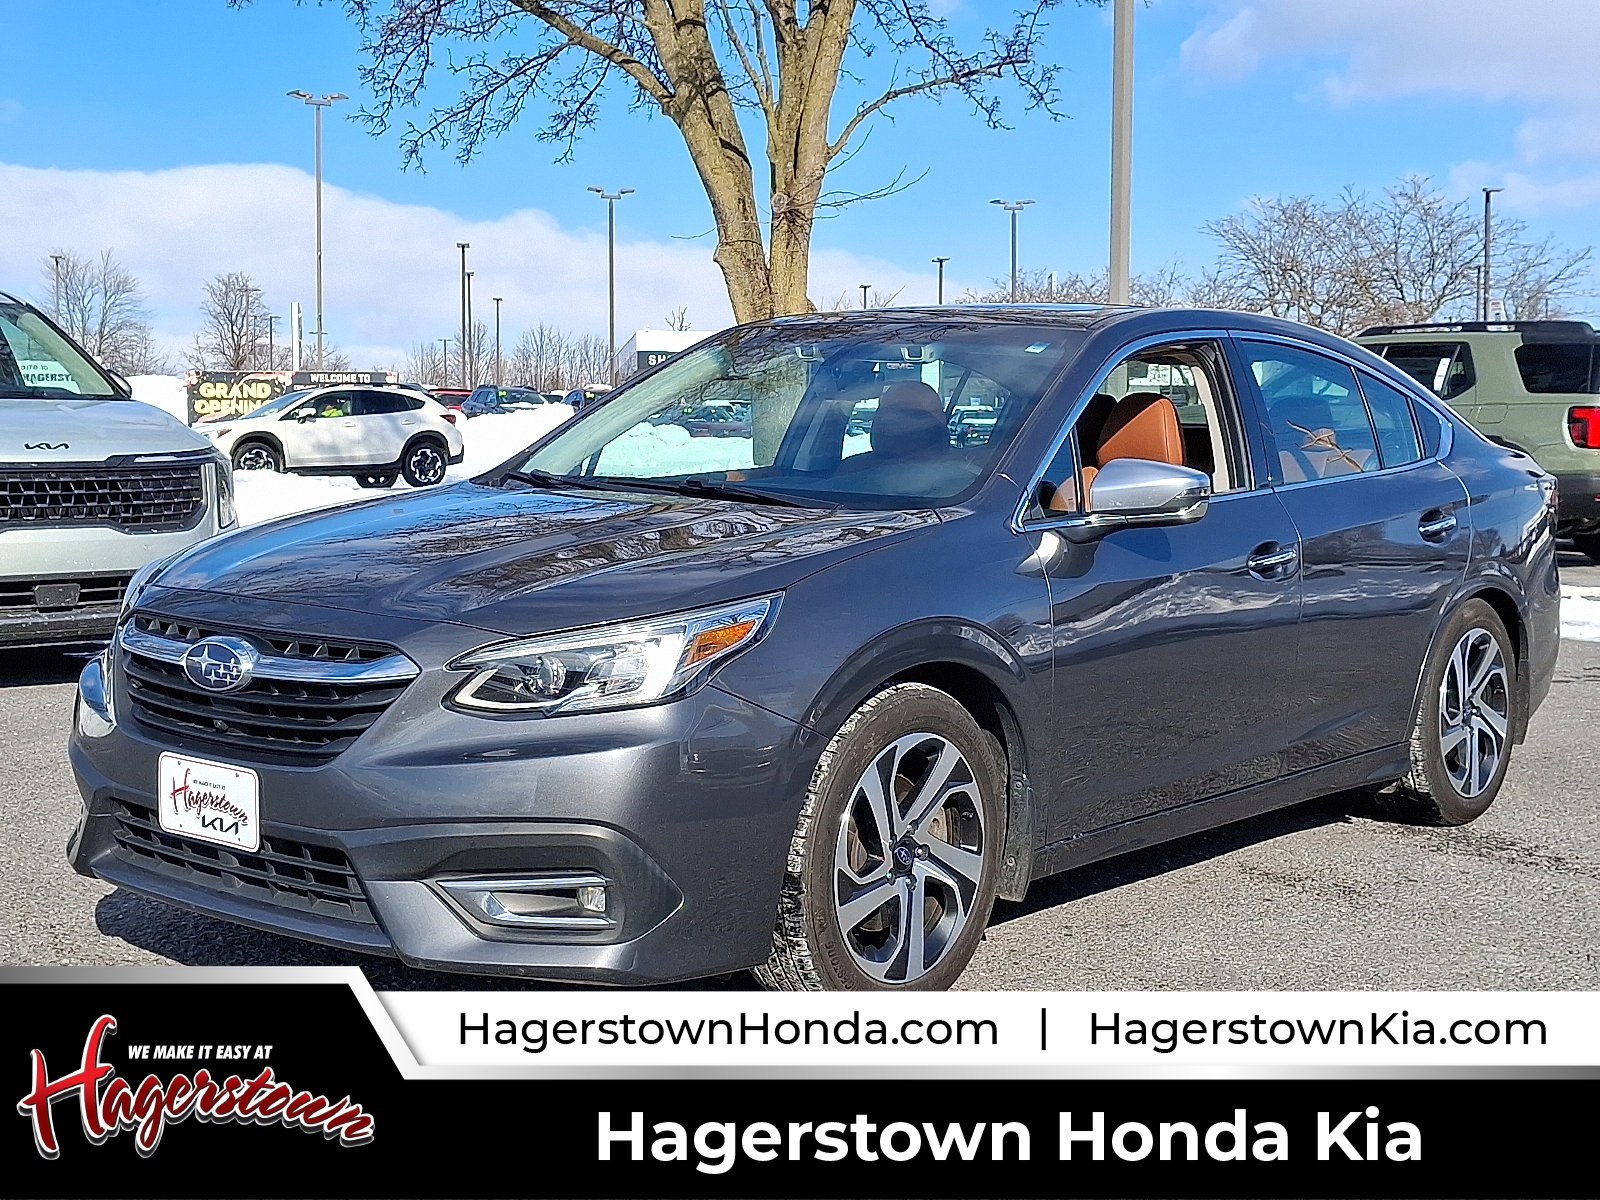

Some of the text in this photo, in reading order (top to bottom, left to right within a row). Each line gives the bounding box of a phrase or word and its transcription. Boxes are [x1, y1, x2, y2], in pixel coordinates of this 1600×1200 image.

[310, 373, 371, 383] WELCOME TO
[198, 382, 272, 398] GRAND
[170, 767, 249, 827] Hagerstown
[201, 815, 239, 835] KIA
